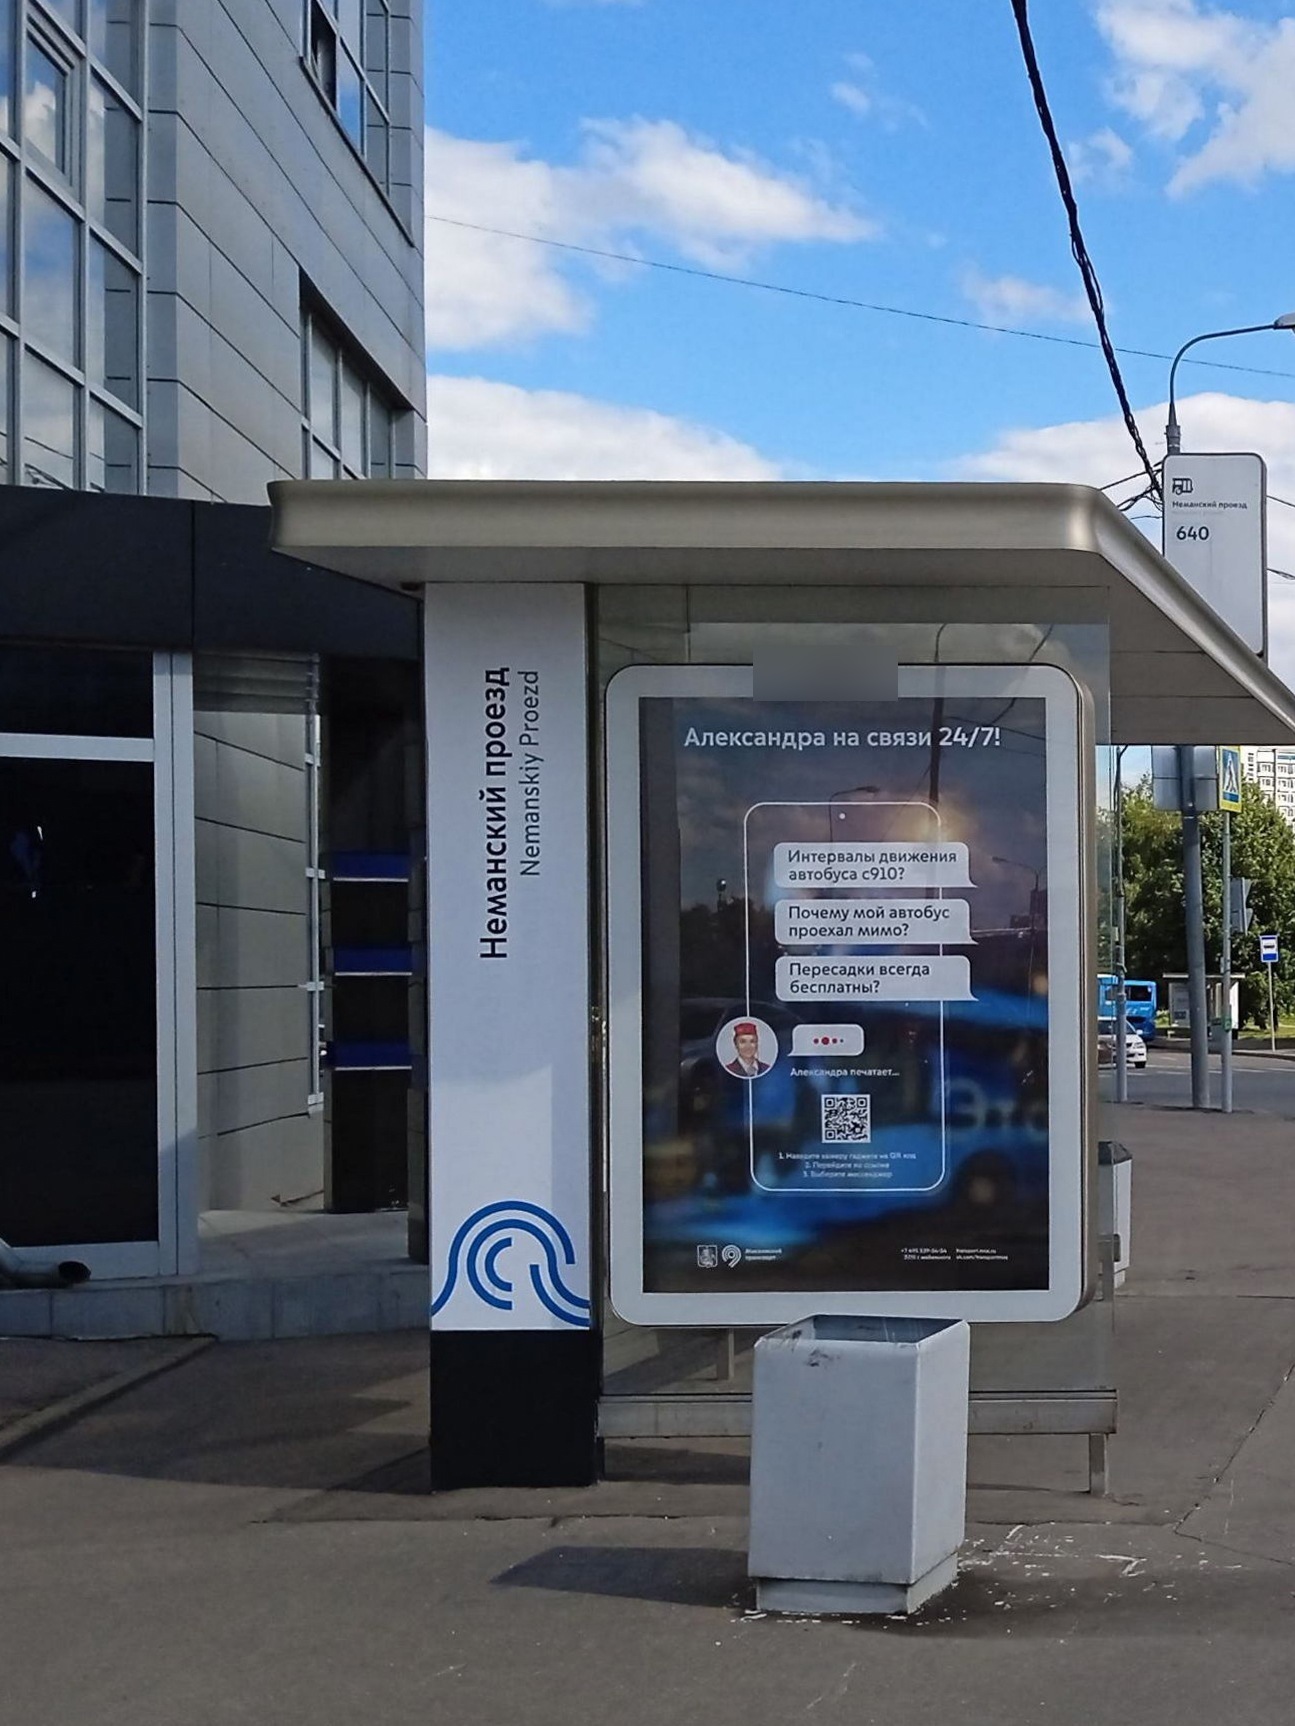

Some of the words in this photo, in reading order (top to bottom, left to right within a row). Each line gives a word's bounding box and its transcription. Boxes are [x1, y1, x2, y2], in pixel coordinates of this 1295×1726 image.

[1172, 500, 1217, 509] Неманский
[1218, 501, 1248, 510] проезд
[1176, 526, 1210, 541] 640
[517, 670, 540, 746] Proezd
[485, 666, 513, 777] проезд
[684, 727, 826, 751] Александра
[833, 731, 859, 747] на
[866, 731, 931, 747] связи
[938, 726, 1001, 748] 24/7!
[518, 752, 545, 876] Nemanskiy
[788, 850, 876, 865] Интервалы
[878, 852, 957, 864] движения
[478, 786, 508, 959] Неманский
[789, 867, 858, 883] автобуса
[861, 867, 905, 881] с910?
[788, 905, 850, 922] Почему
[853, 906, 885, 919] мой
[889, 905, 950, 921] автобус
[789, 926, 854, 939] проехал
[857, 923, 909, 937] мимо?
[789, 962, 875, 978] Пересадки
[879, 965, 931, 978] всегда
[789, 979, 880, 994] бесплатны?
[790, 1067, 848, 1078] Александра
